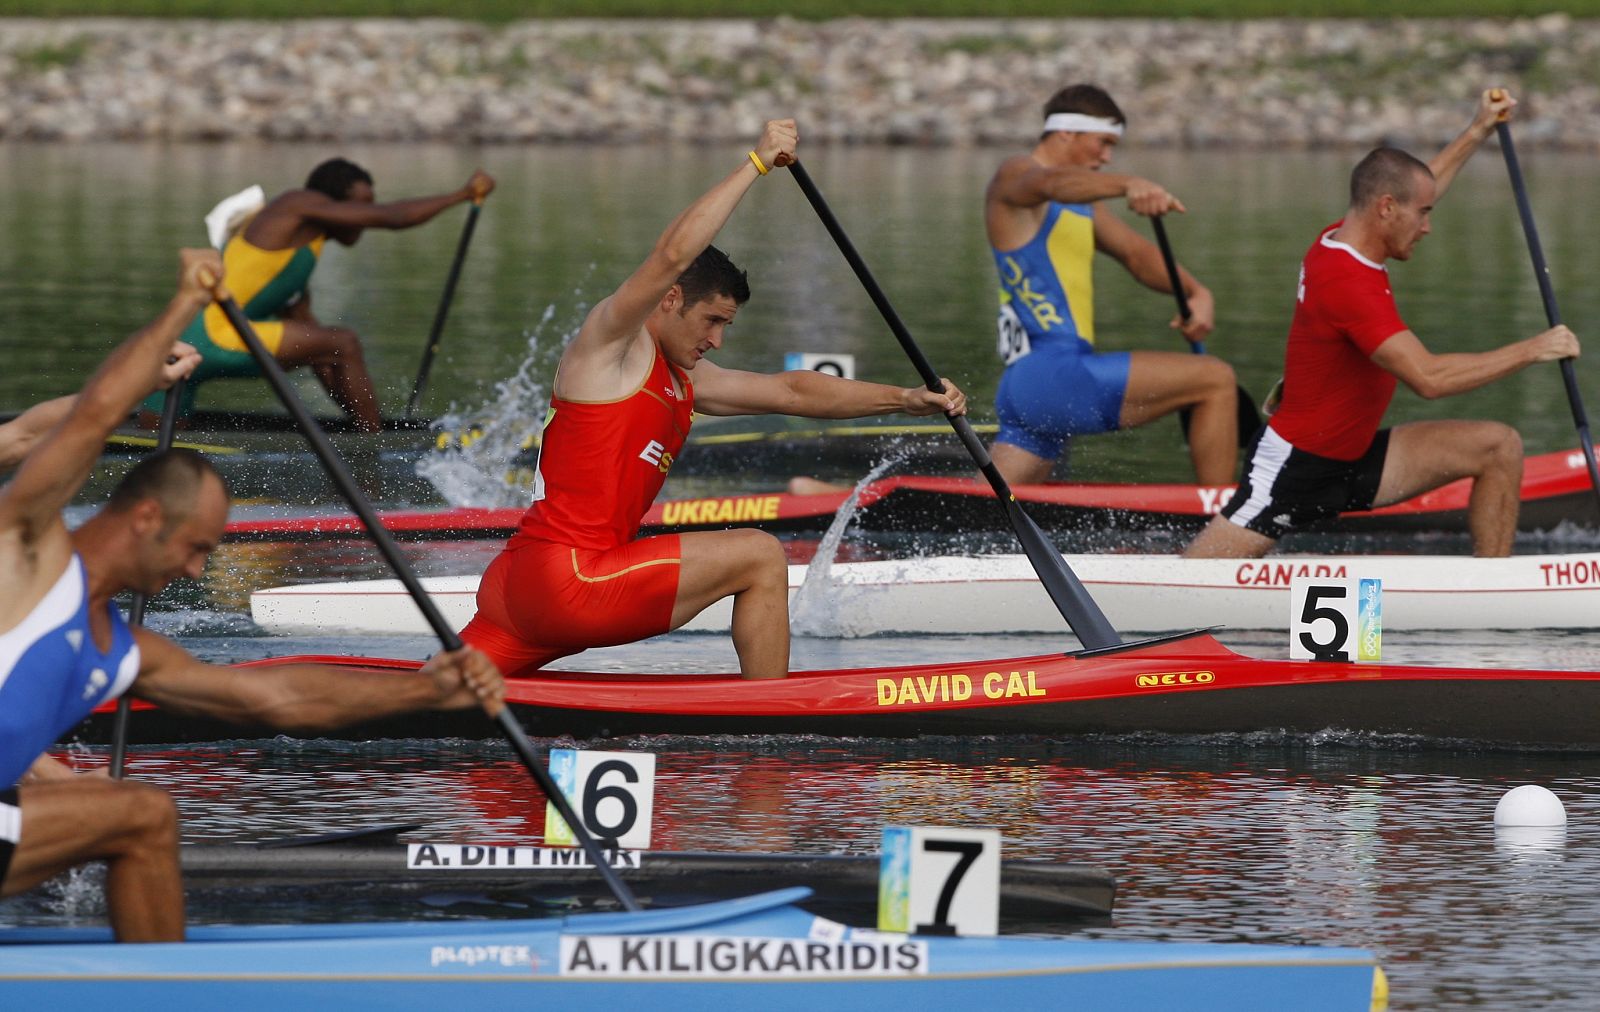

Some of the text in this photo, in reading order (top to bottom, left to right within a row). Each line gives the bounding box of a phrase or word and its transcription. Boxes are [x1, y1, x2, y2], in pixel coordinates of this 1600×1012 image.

[1005, 256, 1063, 331] UKR
[639, 439, 673, 475] ES
[662, 496, 780, 525] UKRAINE
[1299, 586, 1349, 655] 5
[876, 671, 1047, 706] DAVID CAL
[1138, 672, 1213, 686] NELO
[582, 760, 639, 839] 6
[413, 845, 450, 866] A.
[923, 839, 984, 925] 7
[568, 938, 921, 972] A. KILIGKARIDIS
